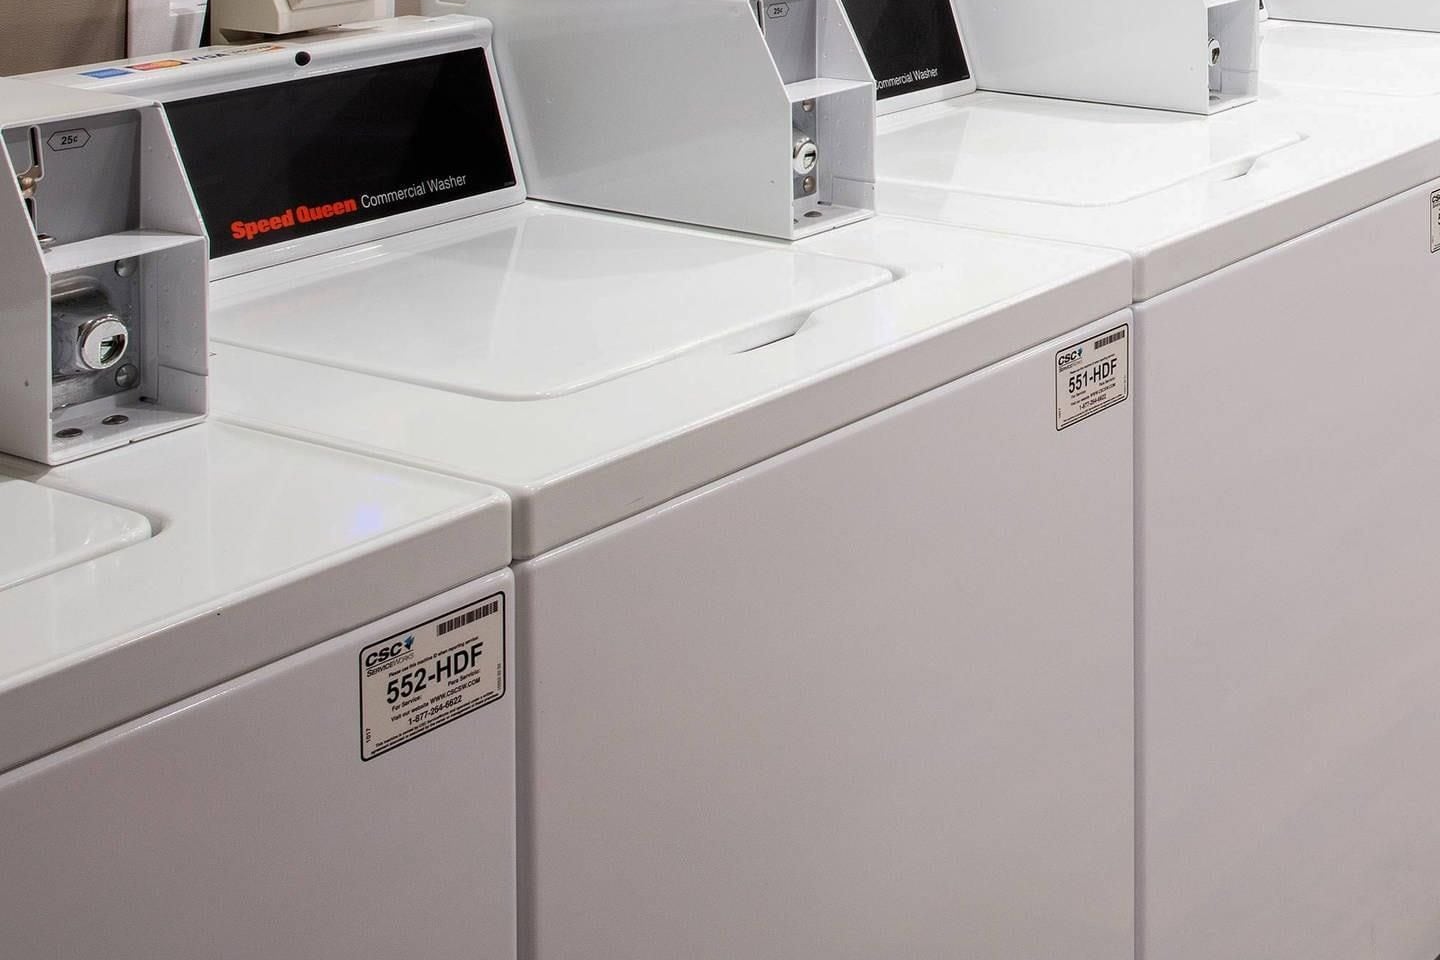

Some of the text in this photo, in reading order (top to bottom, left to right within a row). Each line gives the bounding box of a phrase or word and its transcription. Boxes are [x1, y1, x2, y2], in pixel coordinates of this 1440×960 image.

[912, 67, 938, 82] Washer
[230, 174, 467, 240] Speed Queen Commercial Washer
[1058, 350, 1077, 366] CSC
[1068, 357, 1118, 394] 551-HDF
[365, 641, 403, 668] CSC
[386, 641, 484, 705] 552-HDF
